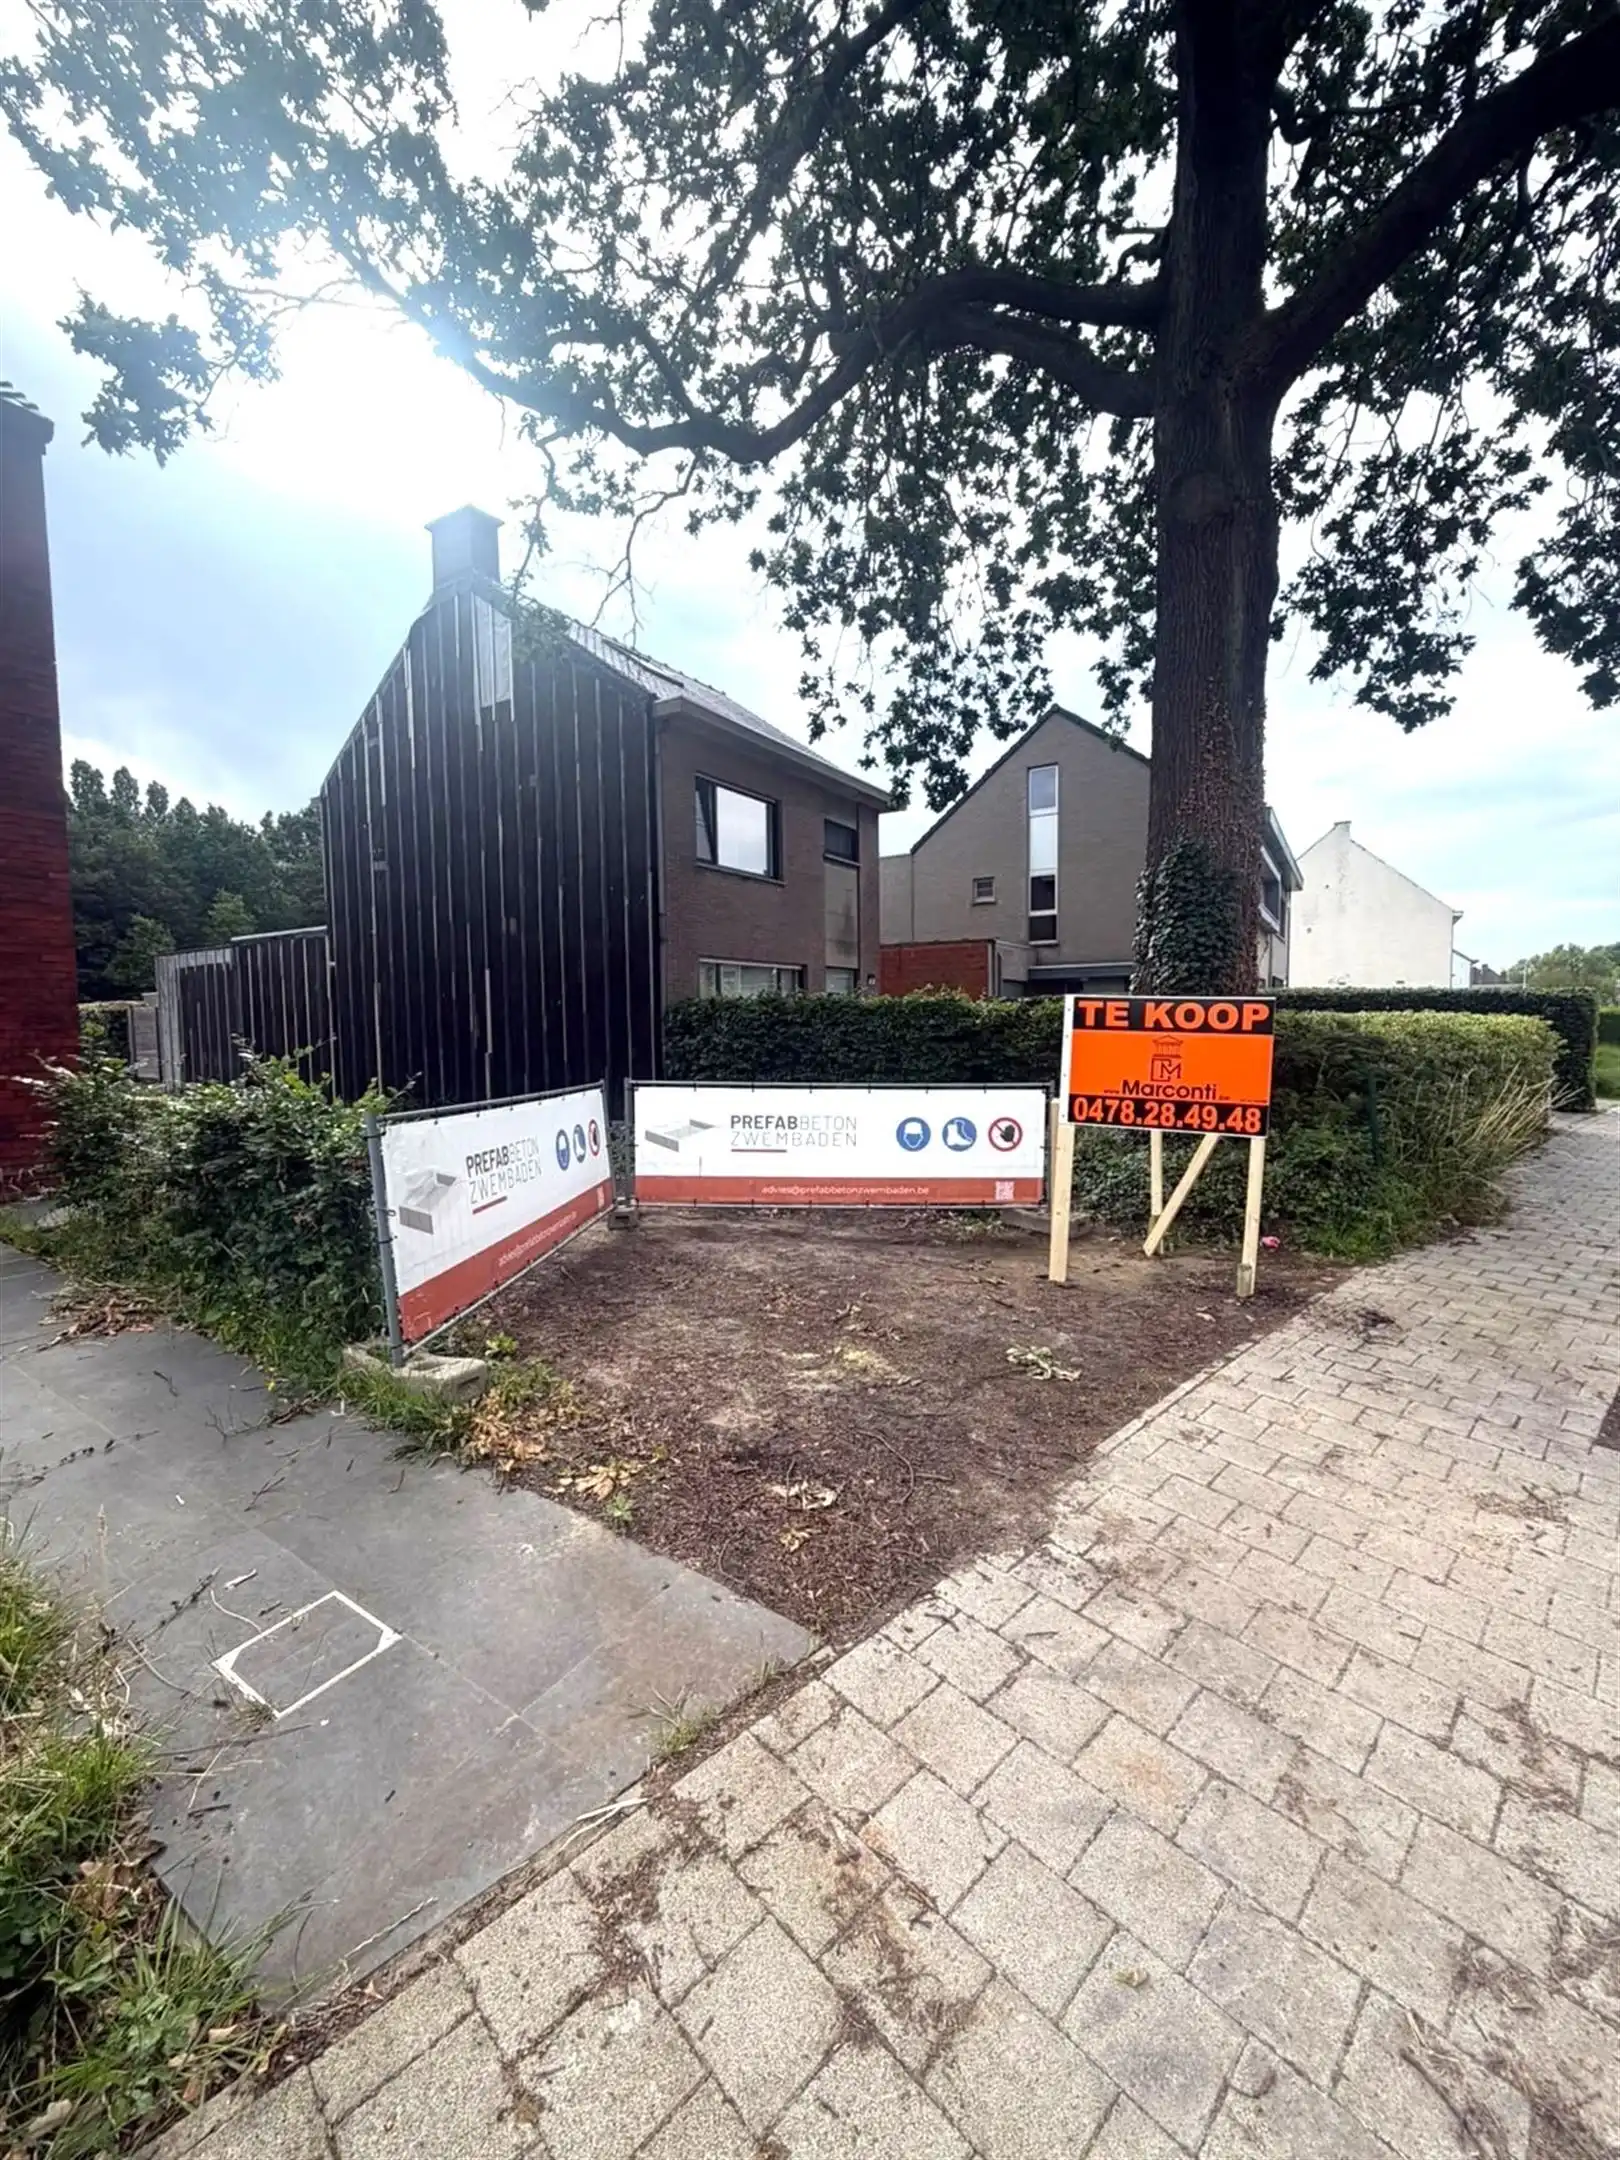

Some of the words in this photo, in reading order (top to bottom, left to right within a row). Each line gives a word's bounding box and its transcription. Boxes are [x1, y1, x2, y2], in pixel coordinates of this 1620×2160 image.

[1078, 1001, 1129, 1027] TE
[1144, 1002, 1270, 1031] KOOP
[1122, 1079, 1217, 1101] Marconti
[1073, 1097, 1262, 1133] 0478.28.49.48
[731, 1131, 857, 1147] ZWEMBADEN
[469, 1158, 543, 1205] ZWEMBADEN
